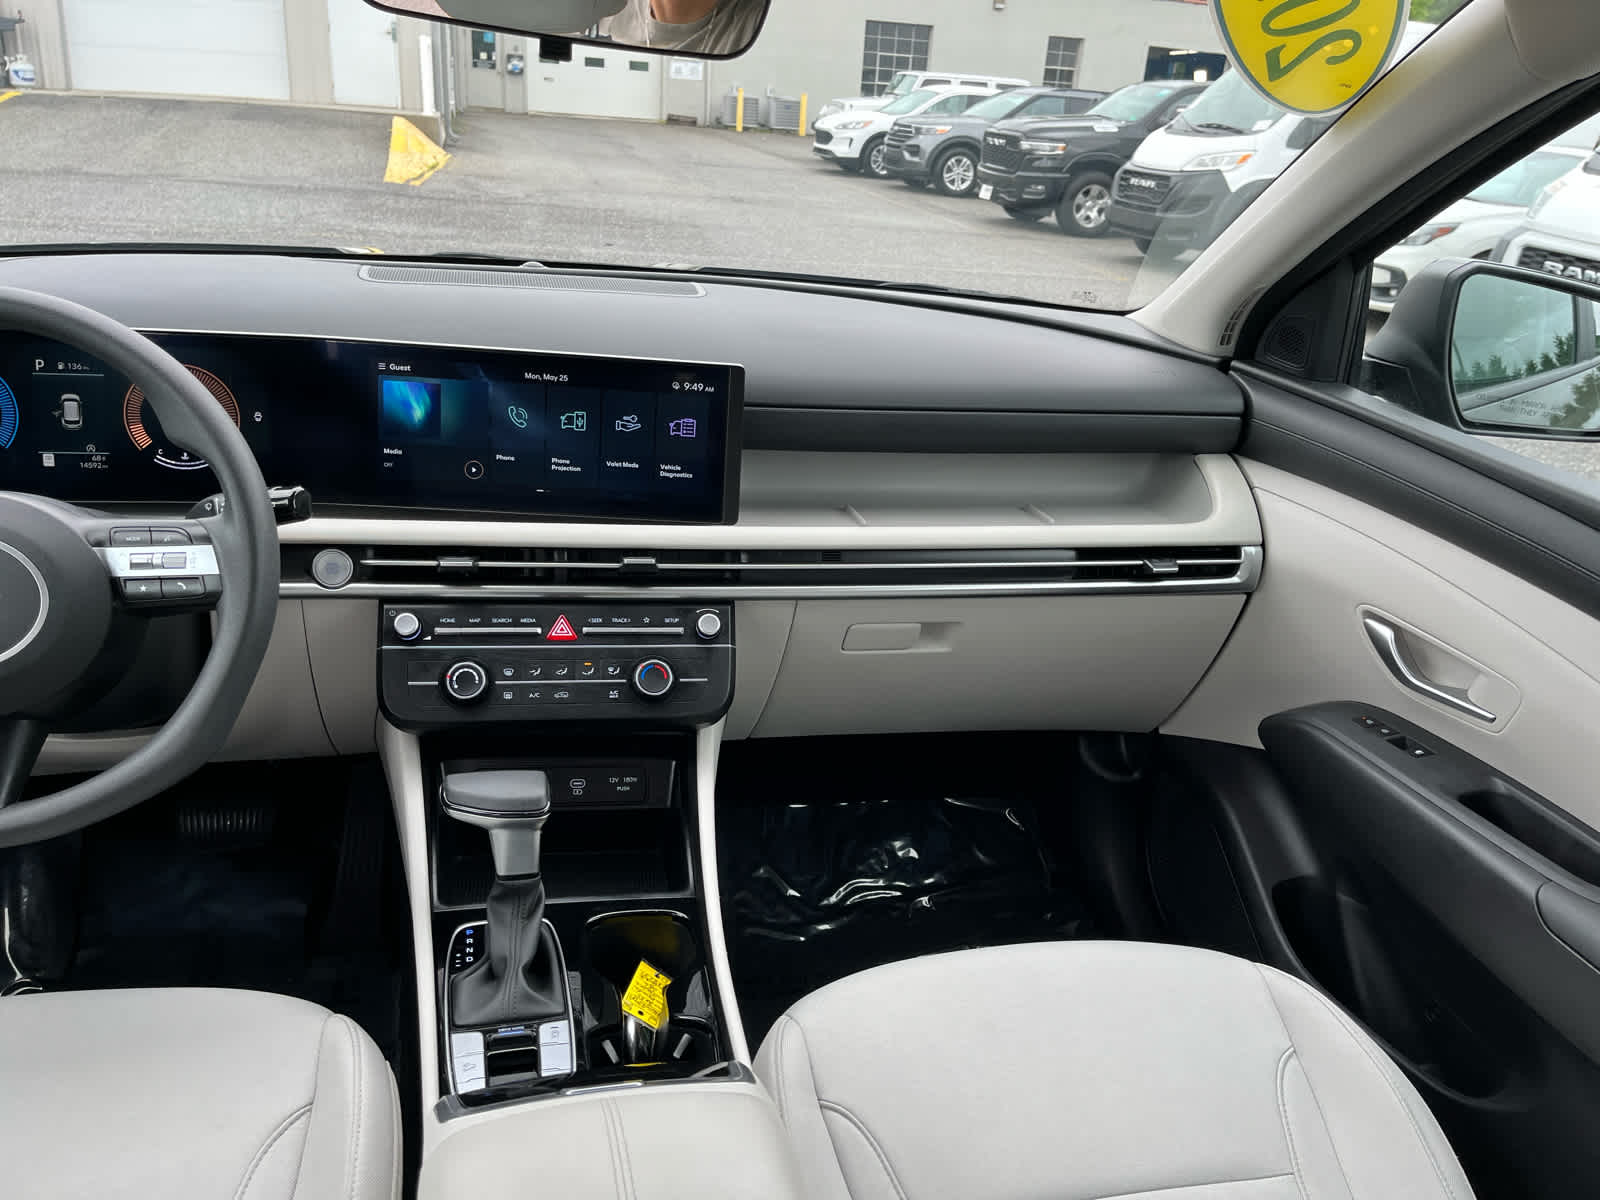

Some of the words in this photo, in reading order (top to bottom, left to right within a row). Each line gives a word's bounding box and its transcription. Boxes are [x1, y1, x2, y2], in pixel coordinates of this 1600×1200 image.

[1543, 260, 1600, 285] RAM
[35, 359, 45, 371] P
[389, 363, 411, 372] Guest
[524, 372, 542, 381] Mon,
[543, 373, 558, 382] May
[559, 374, 569, 382] 25
[683, 382, 704, 392] 9:49
